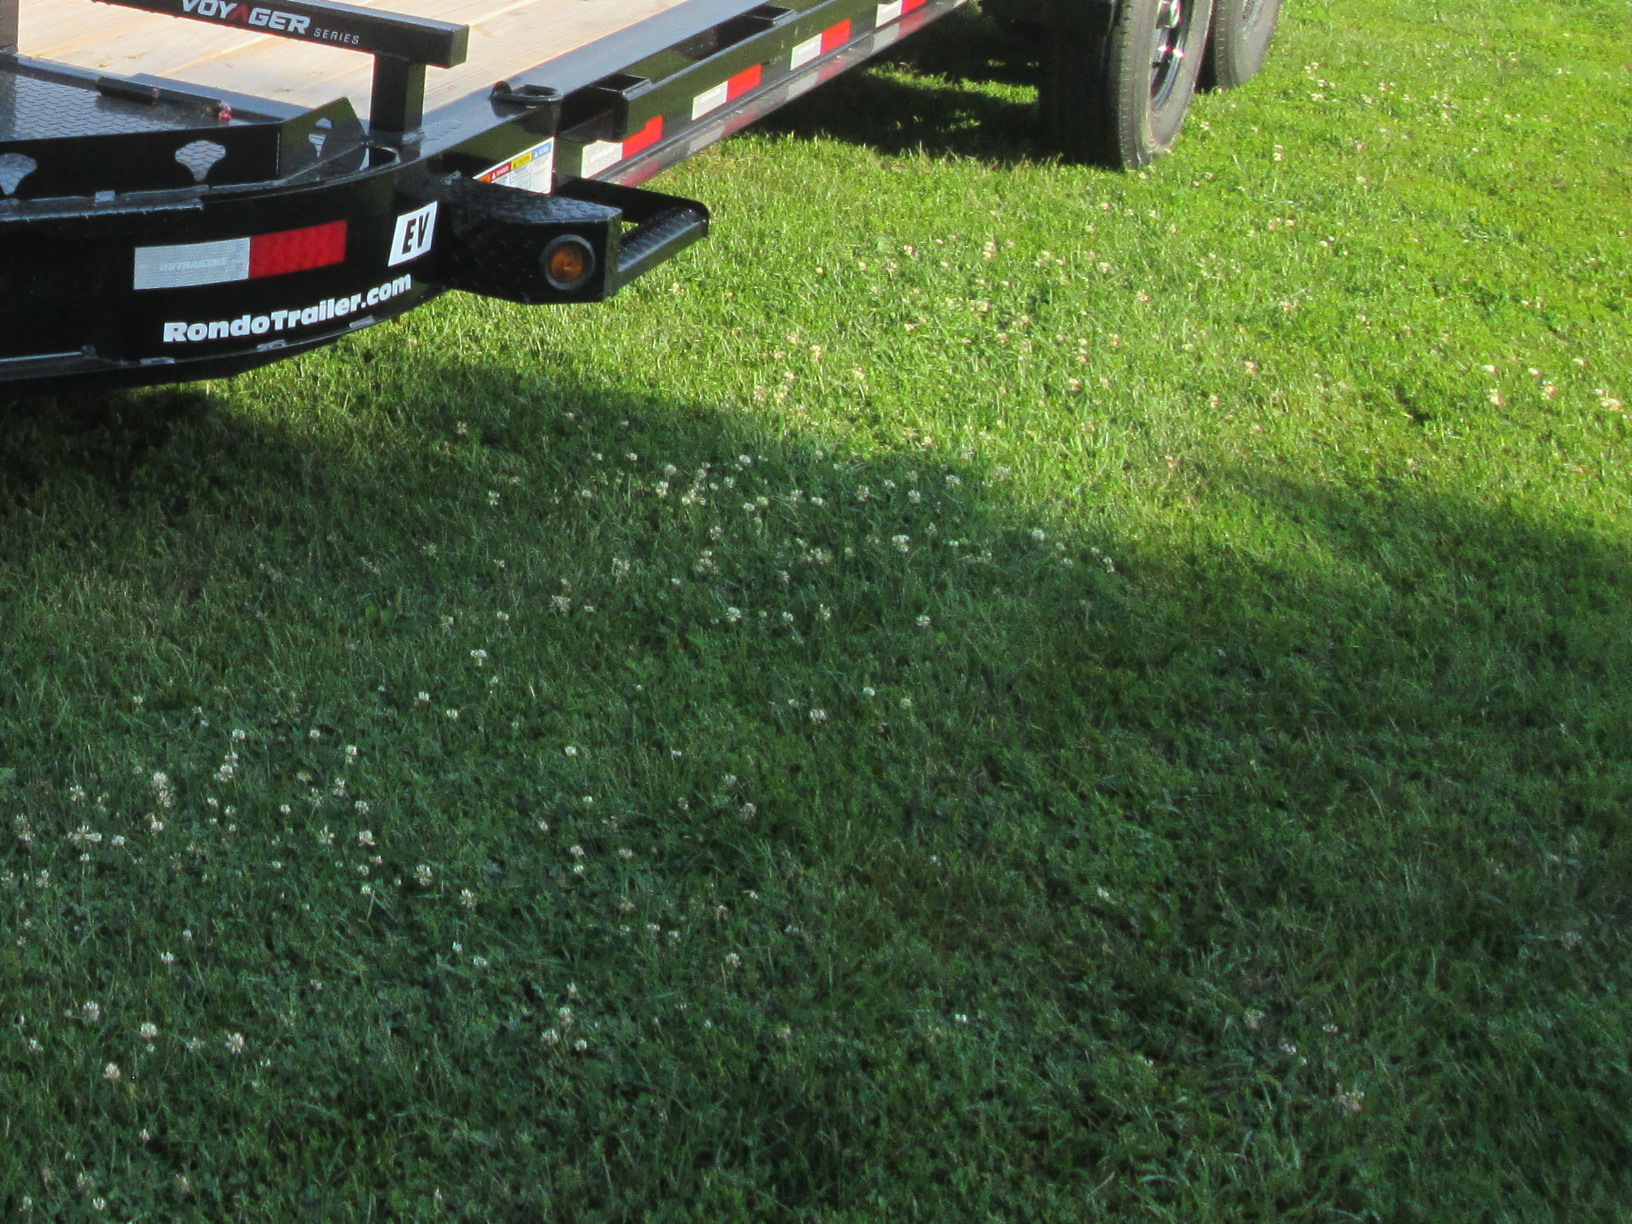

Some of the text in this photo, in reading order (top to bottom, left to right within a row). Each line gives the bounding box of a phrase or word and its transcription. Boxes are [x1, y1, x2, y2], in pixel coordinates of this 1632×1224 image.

[313, 27, 360, 45] SERIES
[401, 211, 431, 255] EV
[163, 273, 413, 343] RondoTrailer.com
